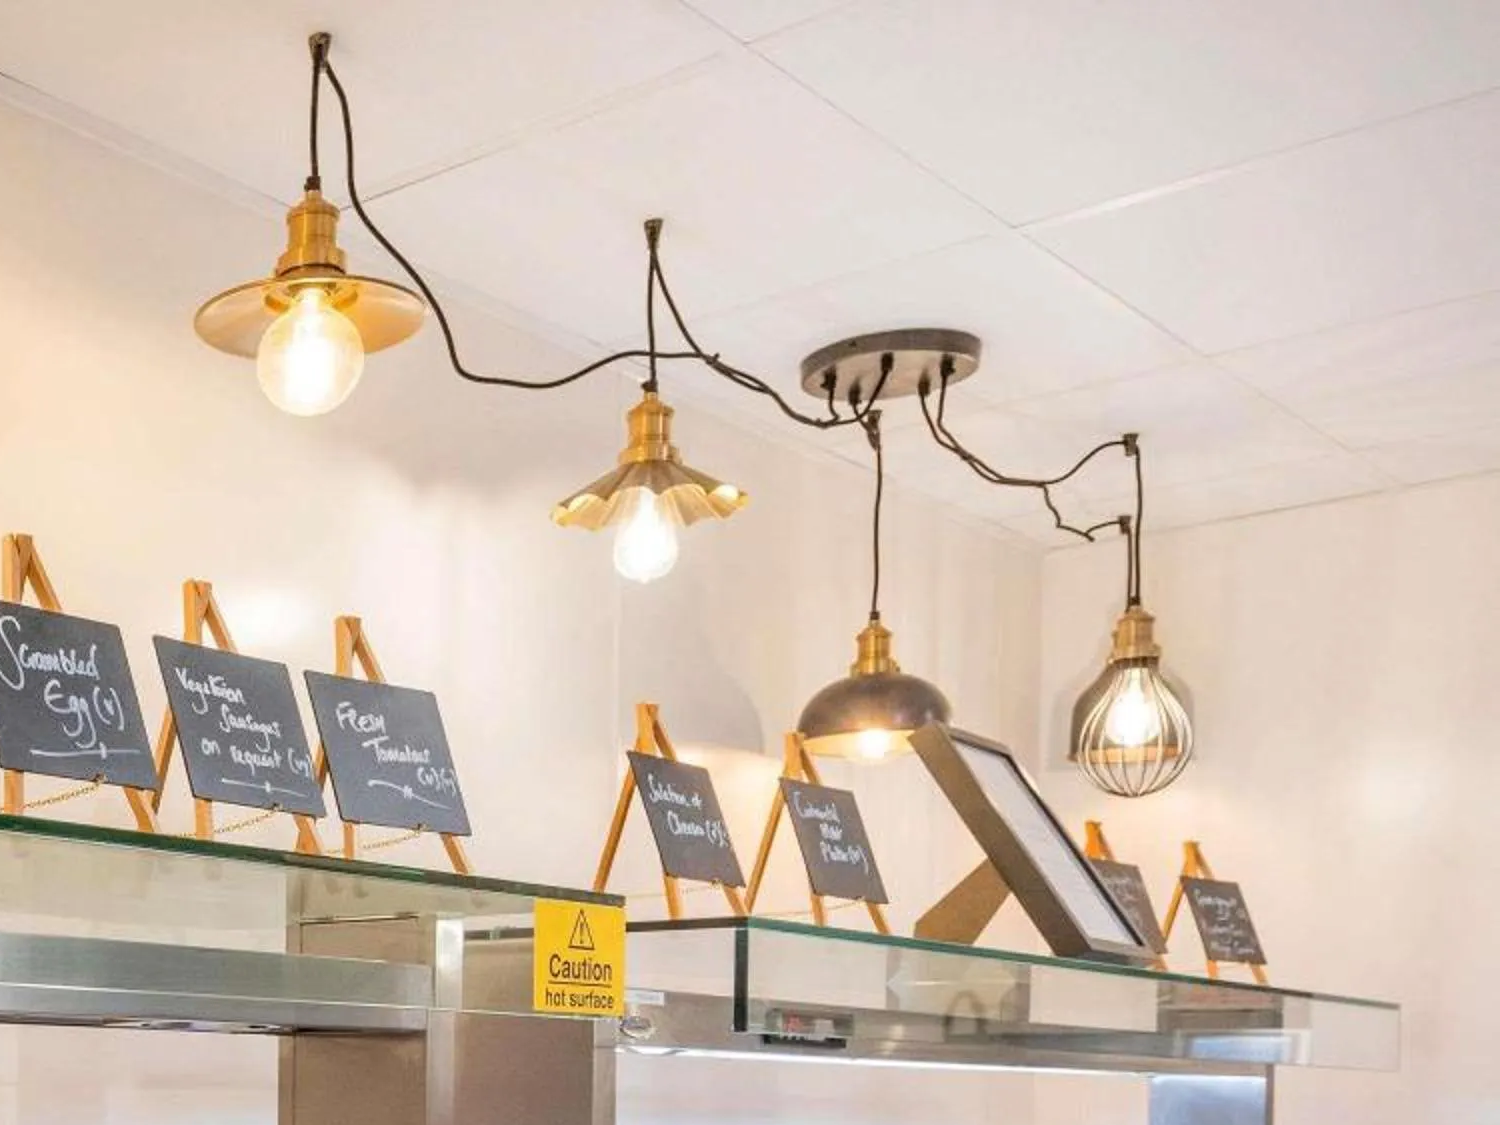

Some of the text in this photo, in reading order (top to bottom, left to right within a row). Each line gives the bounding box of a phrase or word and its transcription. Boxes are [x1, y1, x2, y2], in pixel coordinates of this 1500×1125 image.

[43, 679, 97, 749] Egg
[201, 738, 221, 755] on
[549, 954, 613, 981] Caution
[545, 988, 567, 1007] hot
[569, 991, 615, 1009] surface
